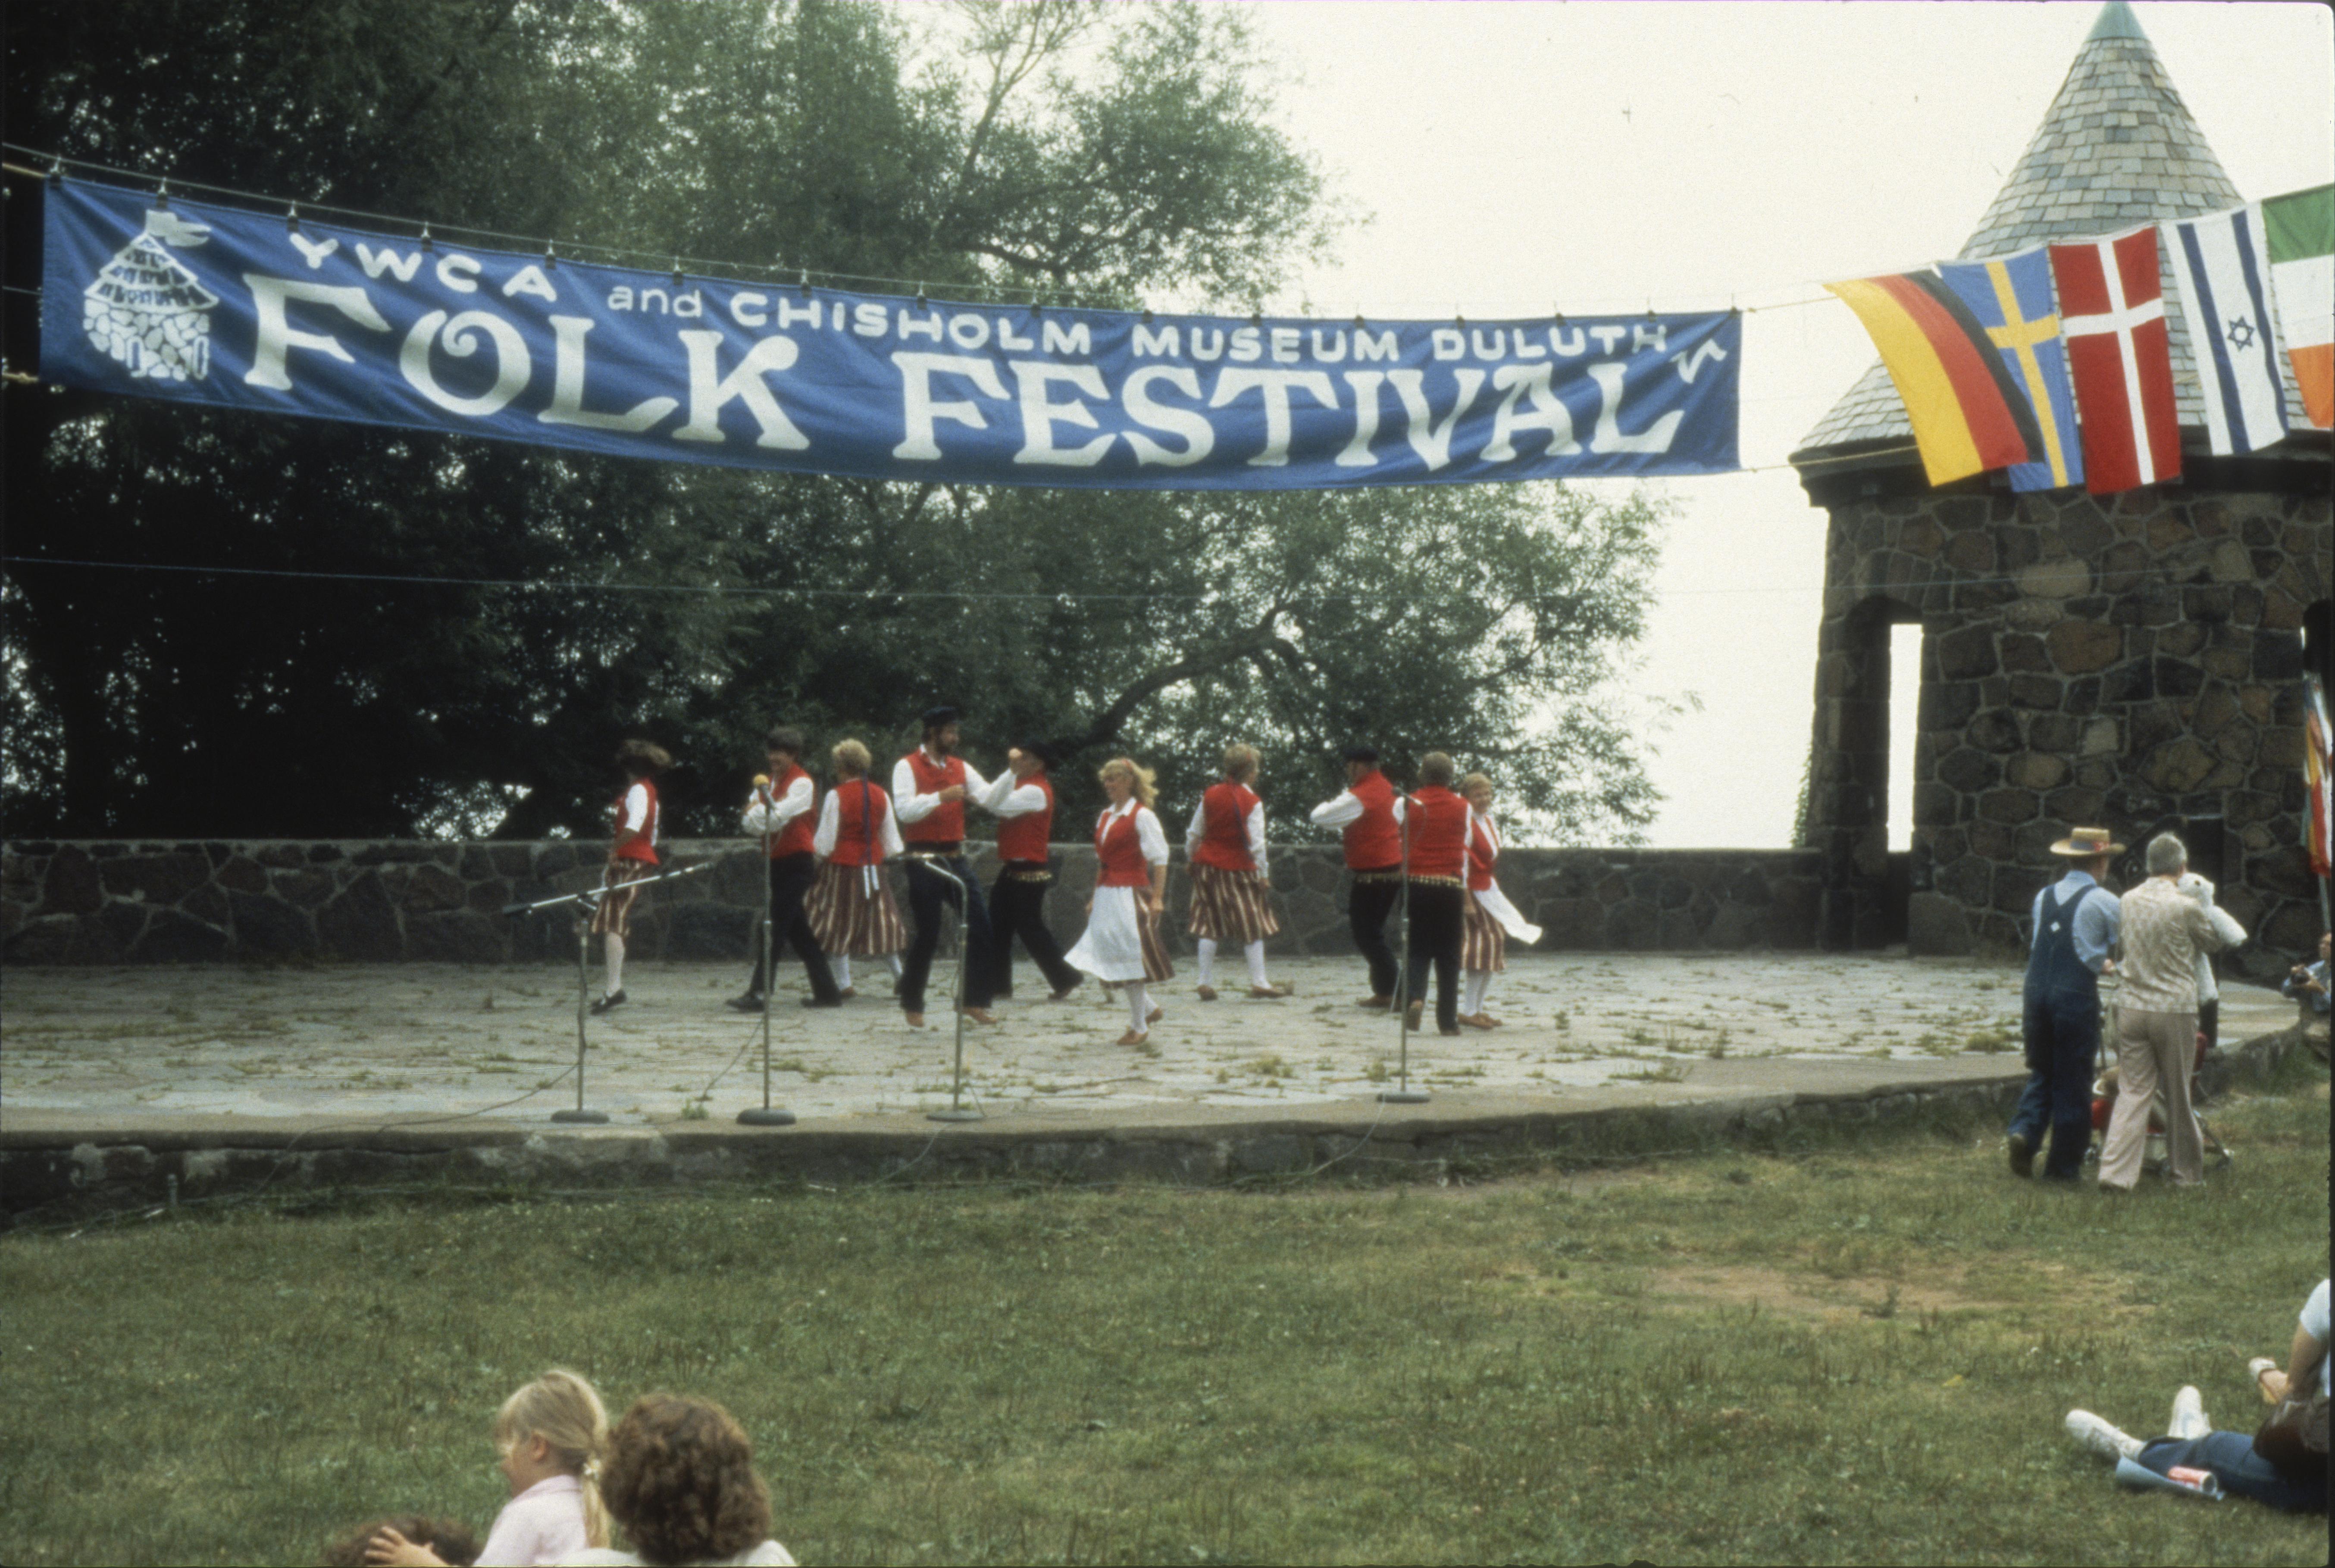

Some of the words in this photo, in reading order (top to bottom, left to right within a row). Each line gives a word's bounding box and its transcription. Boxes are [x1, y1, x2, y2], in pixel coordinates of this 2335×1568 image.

[242, 272, 811, 450] FOLK
[890, 350, 1685, 471] FESTIVAL
[289, 232, 557, 303] YWCA
[607, 285, 703, 318] and
[729, 291, 1091, 355] CHISHOLM
[1131, 323, 1400, 364] MUSEUM
[1430, 323, 1668, 363] DULUTH
